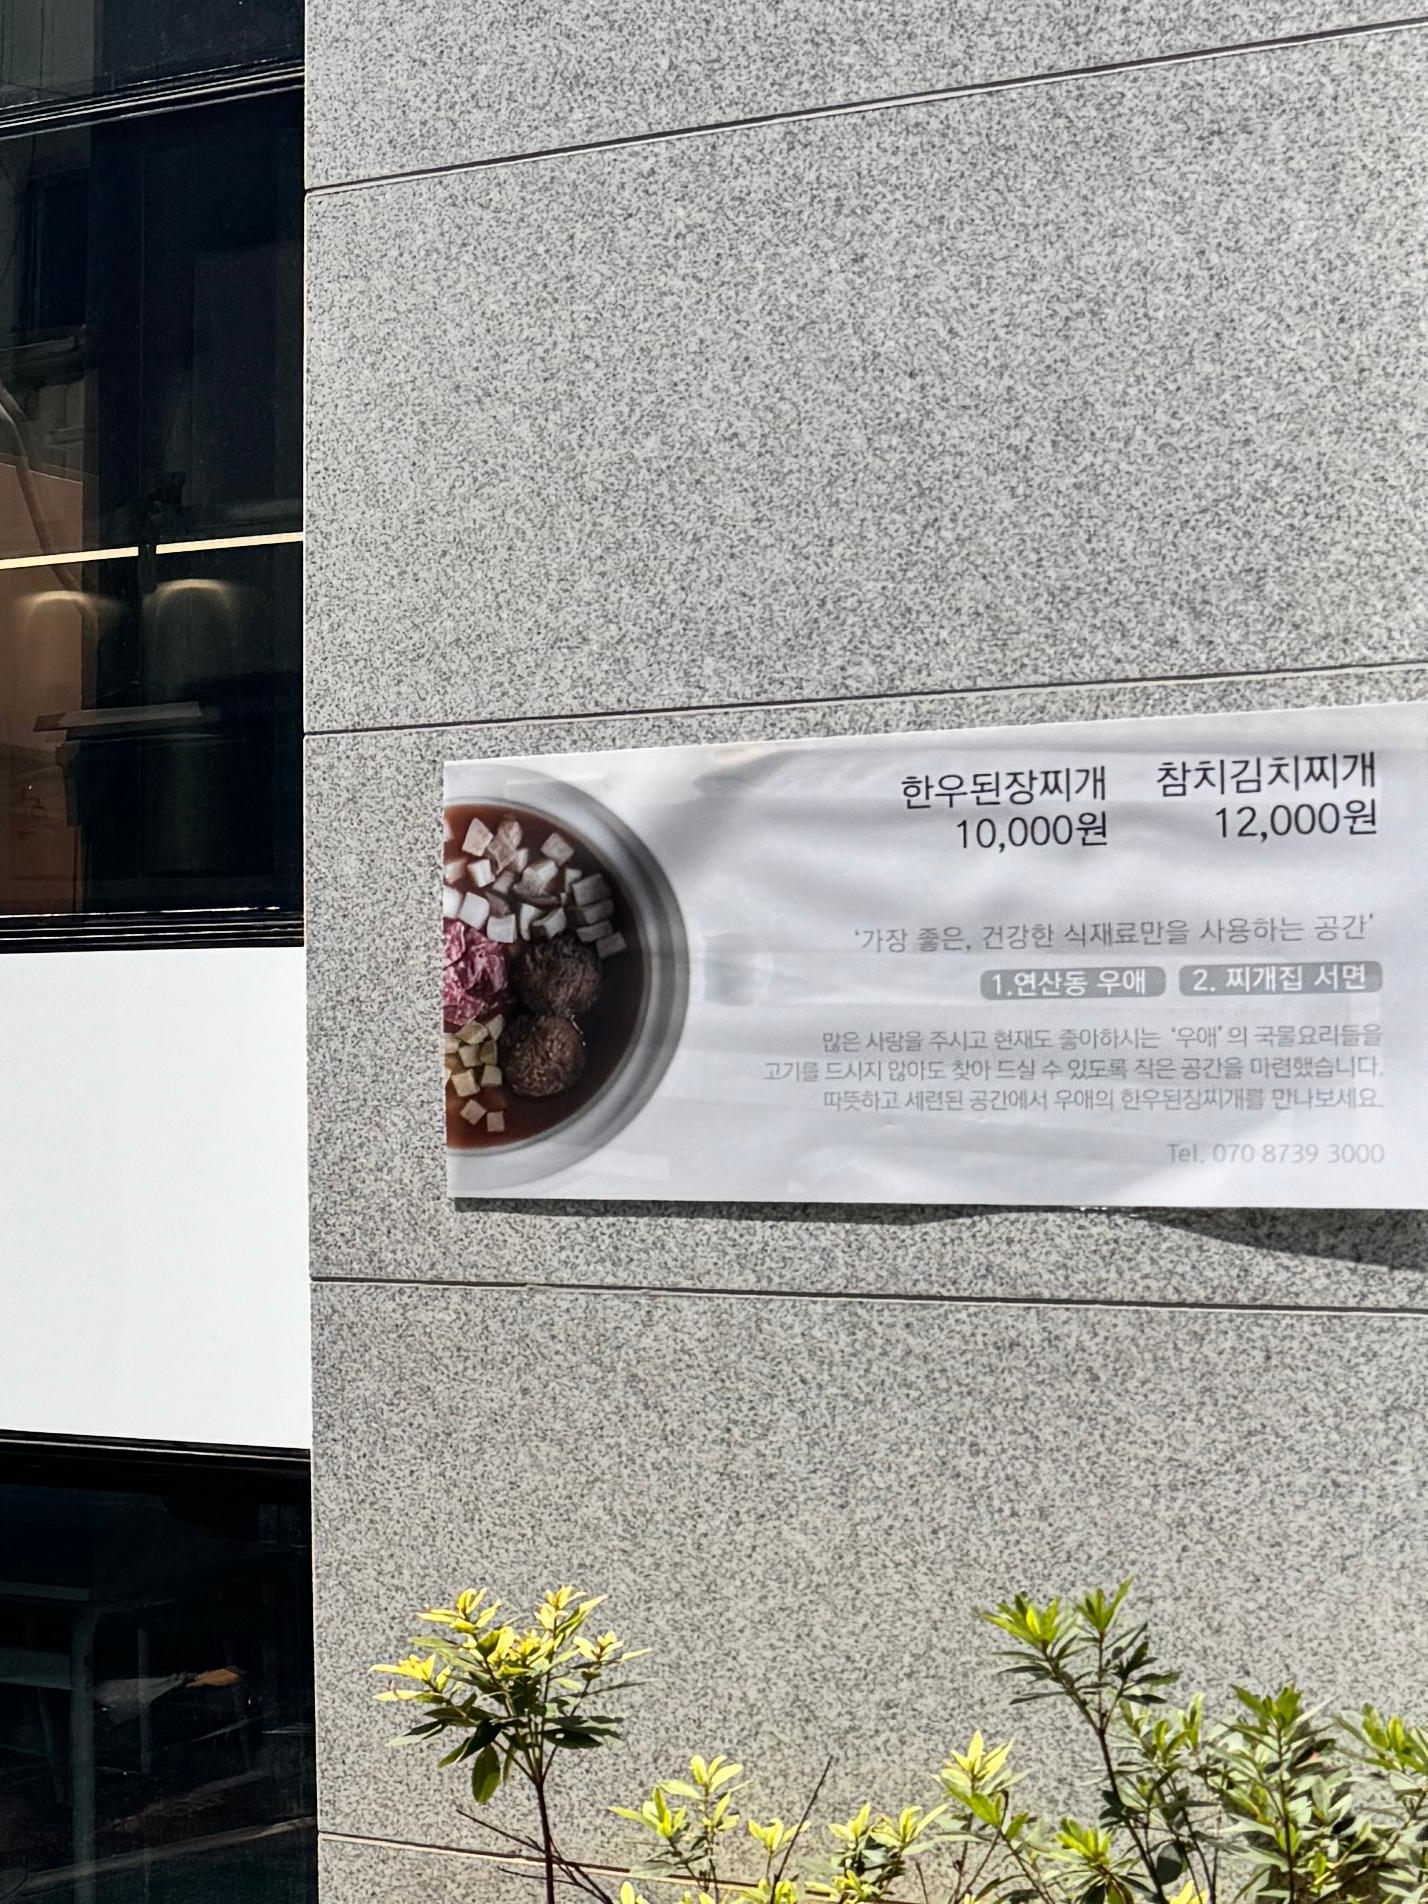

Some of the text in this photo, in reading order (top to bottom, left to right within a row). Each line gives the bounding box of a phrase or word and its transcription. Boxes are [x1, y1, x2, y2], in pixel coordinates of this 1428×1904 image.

[900, 765, 1108, 810] 한우된장찌개
[1156, 751, 1376, 798] 참치김치찌개
[956, 811, 1108, 853] 10,000원
[1214, 798, 1377, 842] 12,000원
[917, 928, 972, 953] 좋은,
[982, 923, 1054, 951] 건강한
[1063, 918, 1190, 948] 식재료만을
[1199, 915, 1305, 944] 사용하는
[1096, 967, 1146, 995] 우애
[1226, 965, 1304, 993] 찌개집
[1313, 963, 1367, 991] 서면
[823, 1031, 861, 1052] 많은
[929, 1030, 987, 1052] 주시고
[994, 1029, 1055, 1051] 현재도
[1059, 1027, 1161, 1050] 좋아하시는
[764, 1061, 820, 1082] 고기를
[825, 1061, 883, 1082] 드시지
[995, 1059, 1035, 1081] 드실
[1041, 1060, 1062, 1080] 수
[1068, 1057, 1128, 1080] 있도록
[1180, 1057, 1243, 1079] 공간을
[824, 1091, 898, 1111] 따뜻하고
[905, 1091, 963, 1111] 세련된
[969, 1090, 1048, 1111] 공간에서
[1212, 1144, 1255, 1163] 070
[1262, 1144, 1319, 1163] 8739
[1327, 1144, 1385, 1163] 3000
